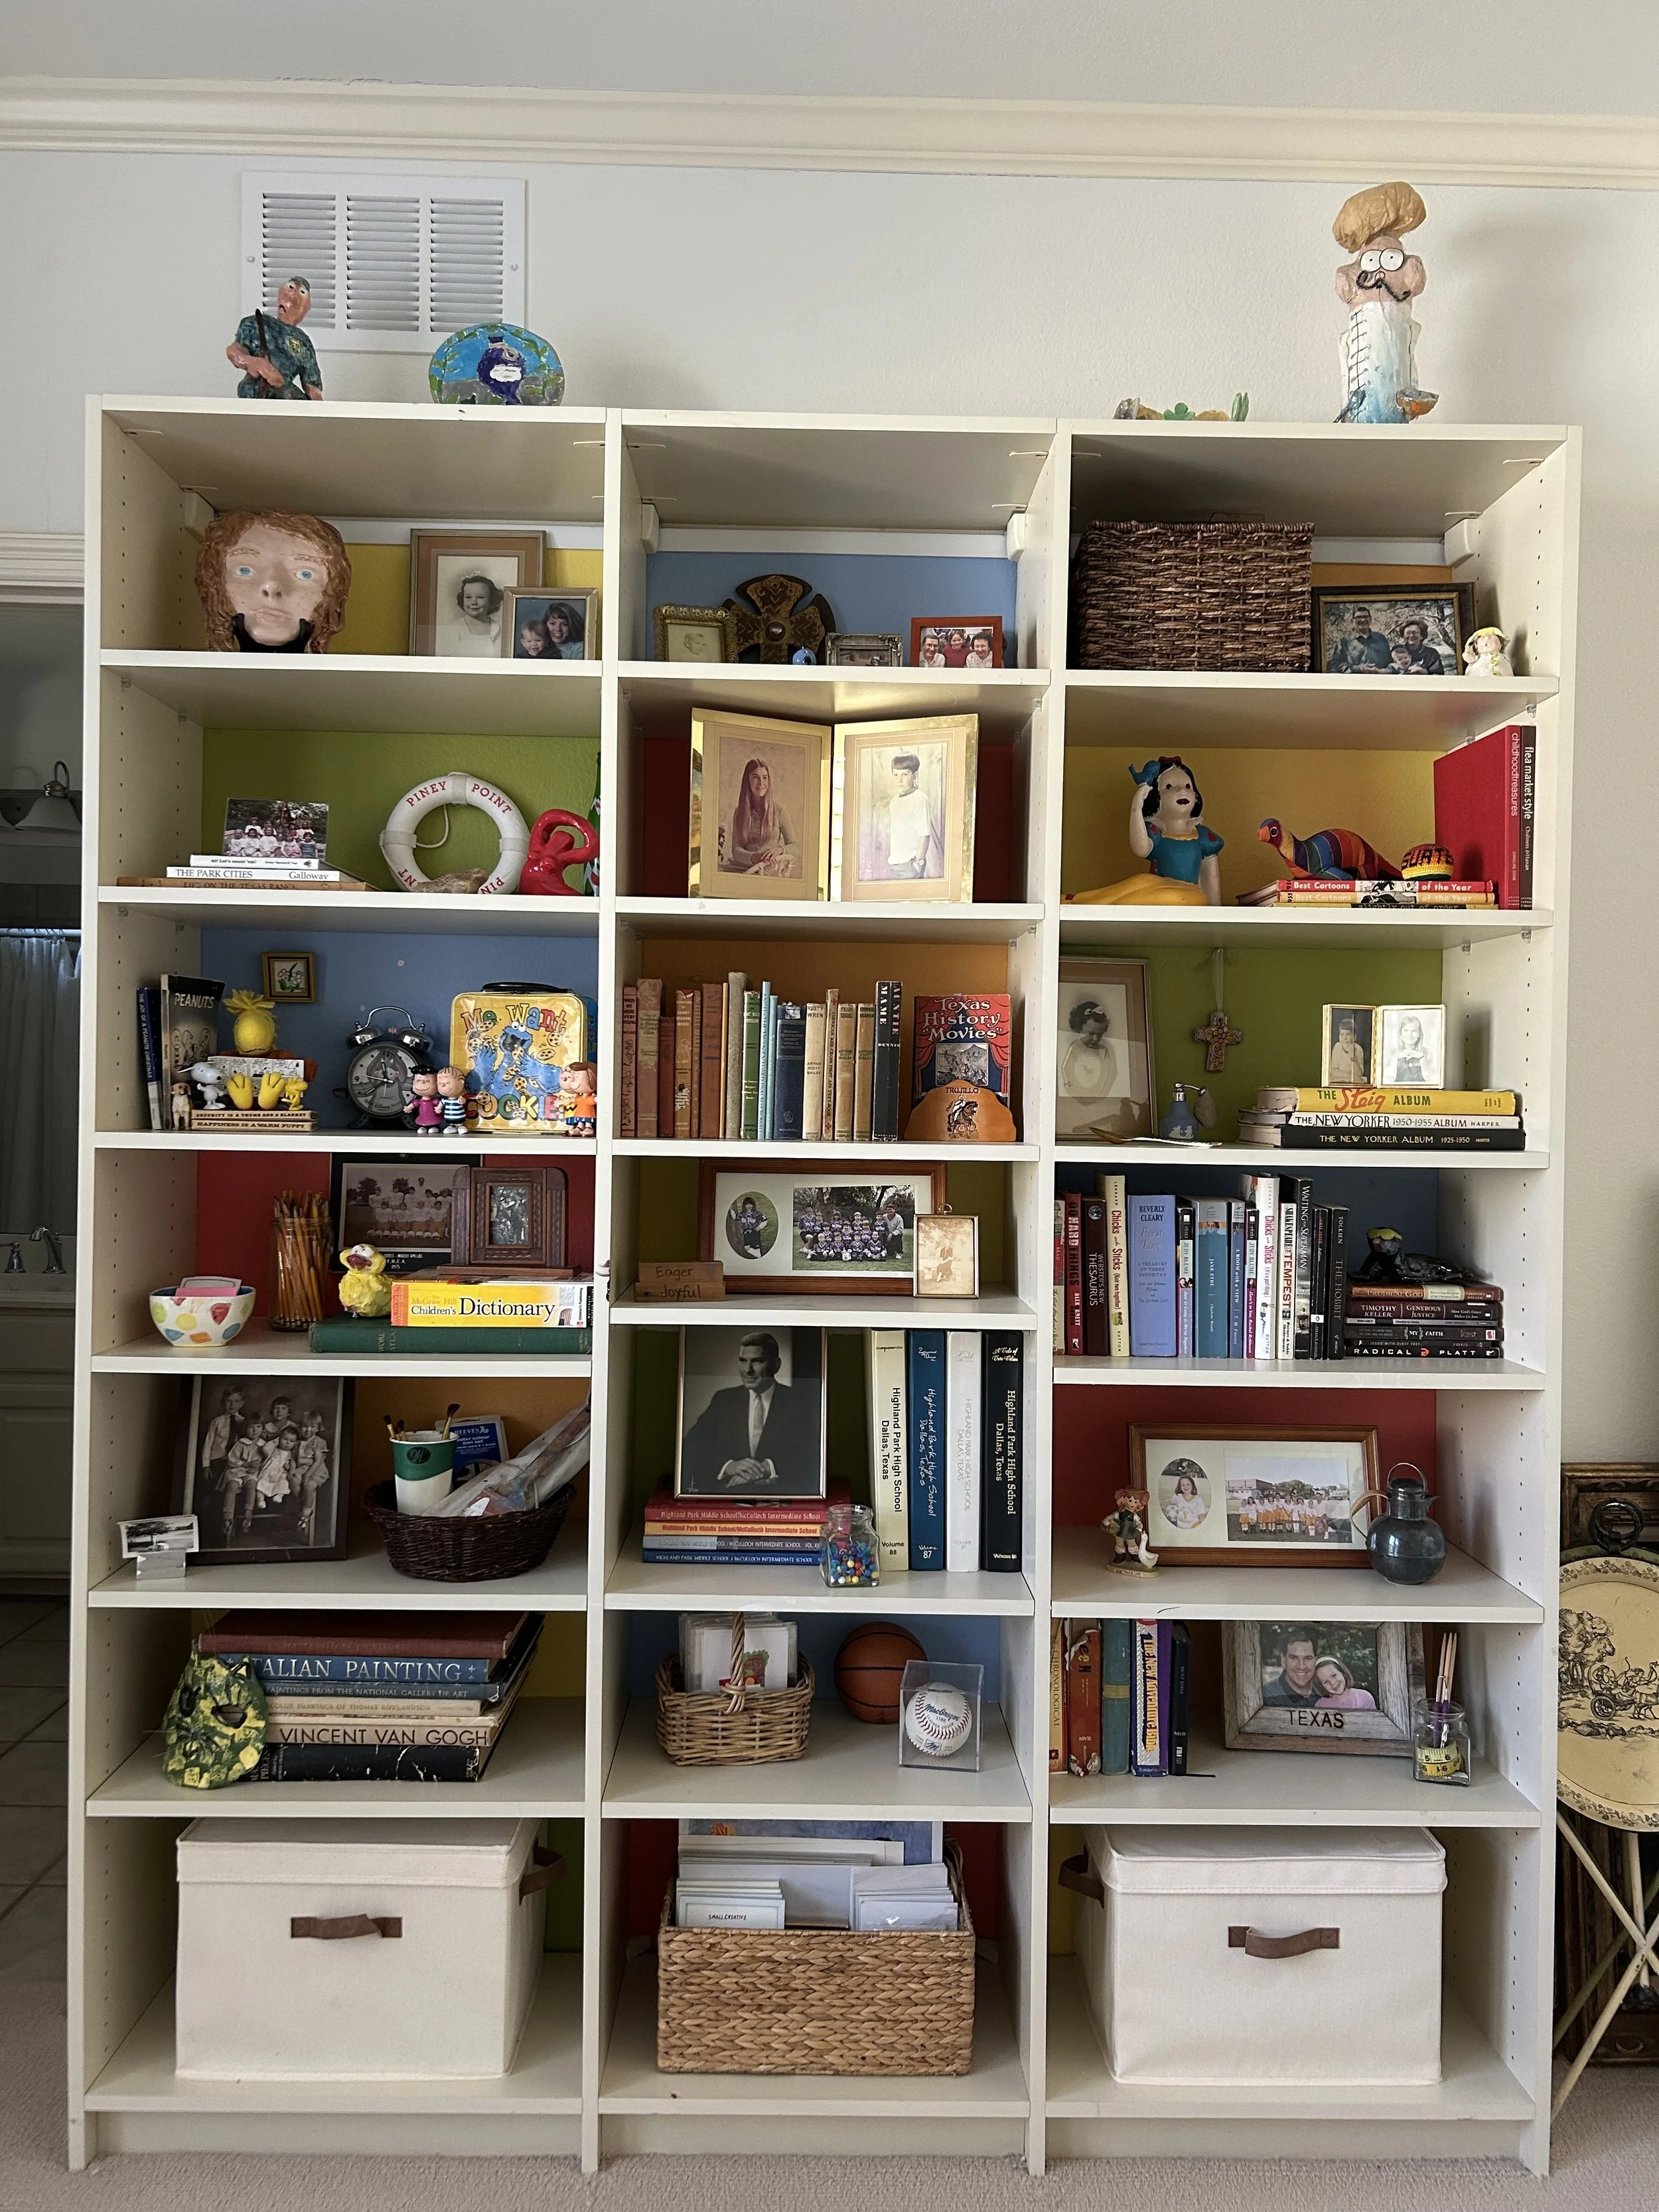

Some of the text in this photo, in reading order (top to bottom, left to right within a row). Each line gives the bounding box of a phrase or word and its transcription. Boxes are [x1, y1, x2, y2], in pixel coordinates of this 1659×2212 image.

[1511, 733, 1520, 816] childhoodtreasures
[1524, 746, 1534, 820] flea market style
[406, 781, 512, 814] PINEY POINT
[197, 869, 220, 879] PARK
[174, 993, 215, 1009] PEANUTS
[879, 986, 888, 1025] MAME
[934, 997, 990, 1012] Texas
[461, 1003, 567, 1034] Me Want
[922, 1011, 1001, 1029] History
[1317, 1088, 1431, 1113] THE Steig ALBUM
[1315, 1115, 1344, 1127] NEW
[1344, 1115, 1391, 1128] YORKER
[1393, 1118, 1432, 1127] 1950-1955
[1433, 1119, 1467, 1128] ALBUM
[1068, 1217, 1079, 1246] HARD
[1284, 1207, 1293, 1248] SHAKESPEARE
[656, 1266, 695, 1281] Eager
[1068, 1247, 1079, 1286] THINGS
[1089, 1253, 1098, 1306] THESAURUS
[1282, 1254, 1293, 1309] TEMPEST
[660, 1284, 701, 1301] Joyful
[1333, 1284, 1342, 1321] HOBBIT
[411, 1305, 457, 1315] Children's
[459, 1297, 555, 1321] Dictionary
[1460, 1329, 1477, 1338] kast
[891, 1387, 901, 1429] Highland
[881, 1420, 890, 1451] Dallas,
[893, 1455, 902, 1477] High
[918, 1419, 928, 1486] Dallas, Texas
[924, 1388, 937, 1516] Highland Park High School
[995, 1423, 1004, 1481] Dallas, Texas
[1005, 1390, 1016, 1514] Highland Park High School
[1143, 1637, 1158, 1753] The New Adventure Bible
[920, 1704, 961, 1722] MacGregor
[1286, 1710, 1344, 1729] TEXAS
[280, 1728, 487, 1746] VINCENT VAN GOGH
